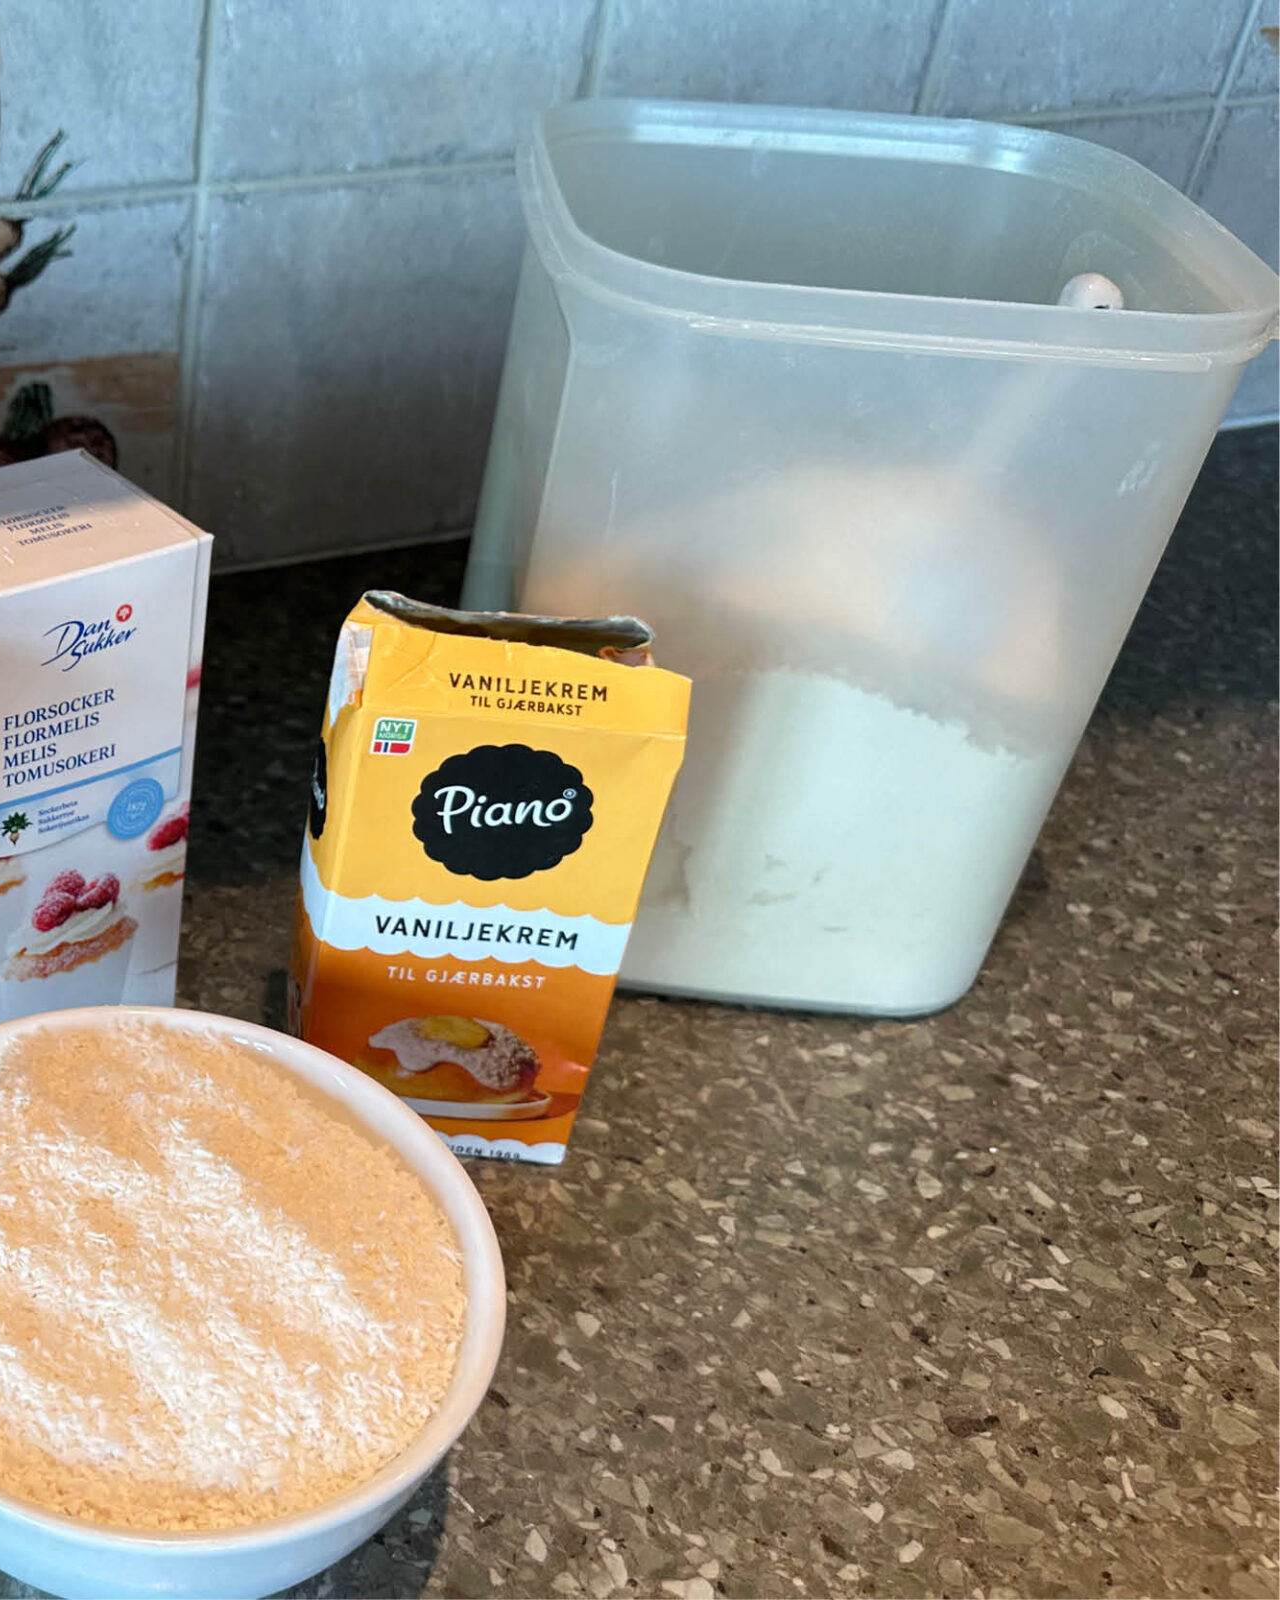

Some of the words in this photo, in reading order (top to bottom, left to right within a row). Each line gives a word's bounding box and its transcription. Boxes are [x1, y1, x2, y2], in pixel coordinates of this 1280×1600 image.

[6, 512, 70, 532] FLORMELIS
[17, 523, 93, 546] TOMUSOKERI
[29, 522, 65, 535] MELIS
[41, 619, 110, 666] Dan
[62, 628, 137, 672] Sukker
[449, 673, 608, 702] VANILJEKREM
[3, 688, 115, 731] FLORSOCKER
[470, 695, 491, 708] TIL
[496, 698, 583, 716] GJÆRBAKST
[3, 712, 100, 751] FLORMELIS
[380, 721, 413, 733] NYT
[3, 743, 57, 770] MELIS
[3, 743, 116, 788] TOMUSOKERI
[434, 785, 573, 834] Piano
[375, 915, 579, 951] VANILJEKREM
[387, 966, 416, 982] TIL
[425, 969, 546, 989] GJÆRBAKST
